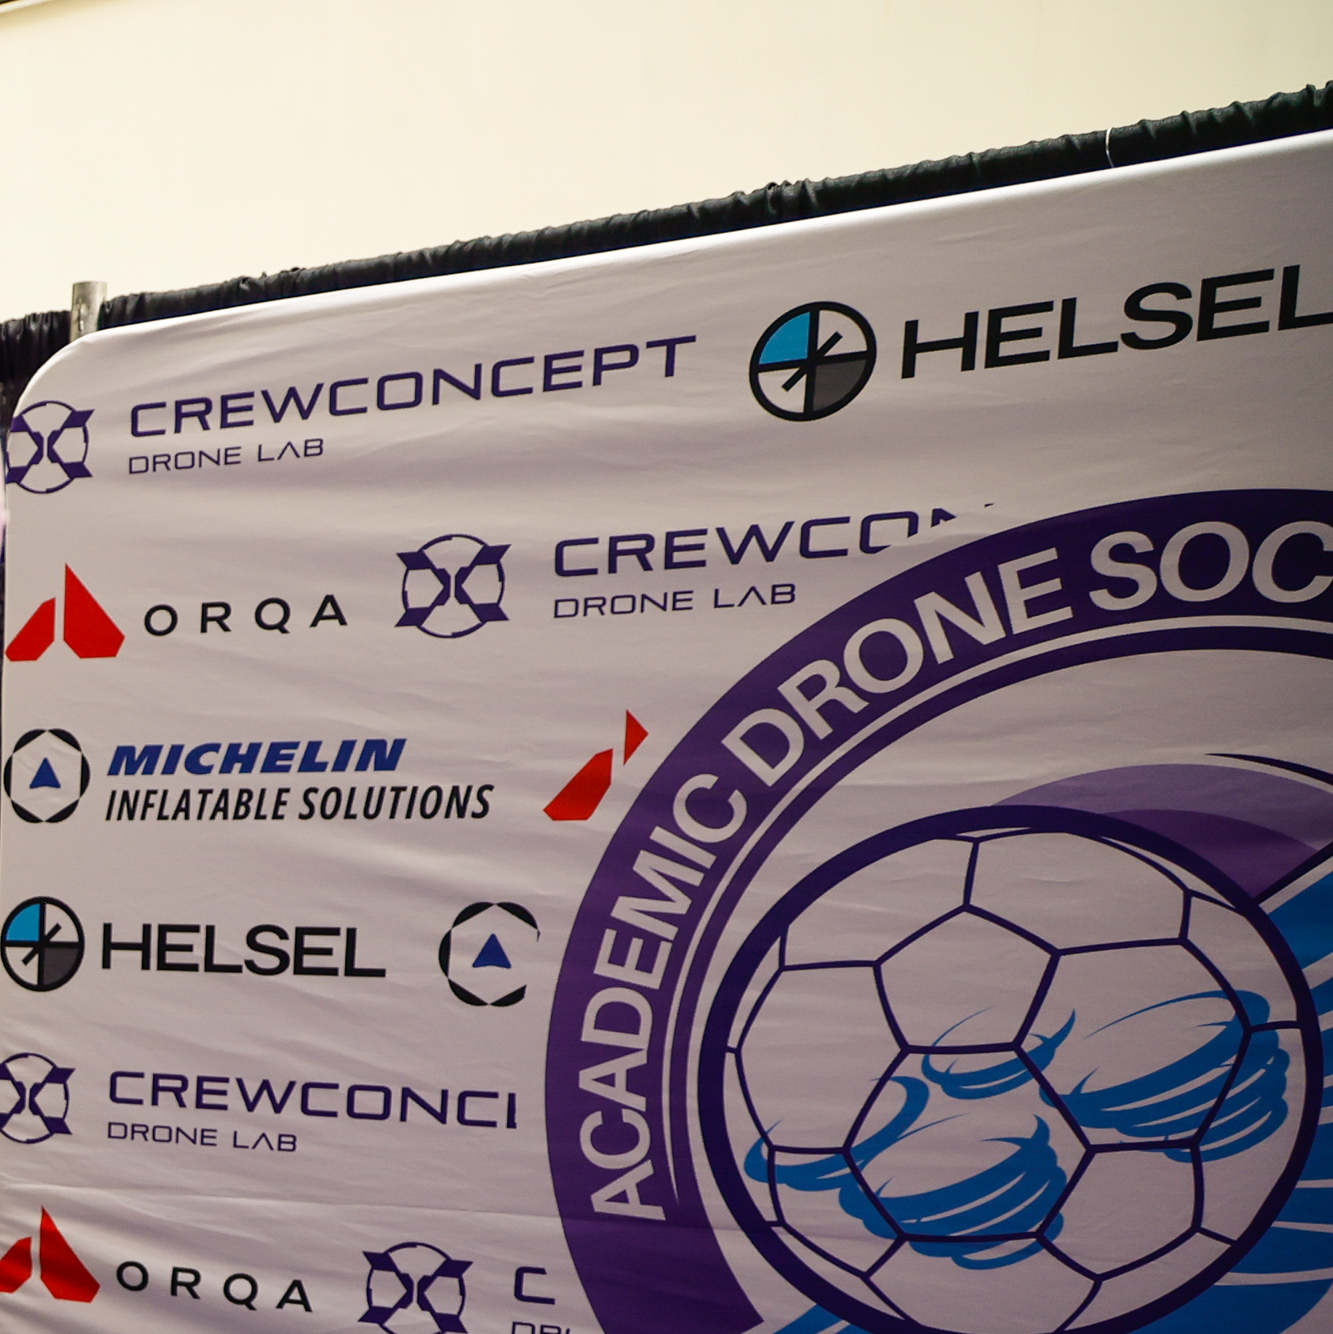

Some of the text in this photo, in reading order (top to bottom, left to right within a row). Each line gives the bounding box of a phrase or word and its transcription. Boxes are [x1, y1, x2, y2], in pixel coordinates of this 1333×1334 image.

[901, 263, 1333, 380] HELSEL
[130, 335, 697, 438] CREWCONCEPT
[128, 438, 325, 475] DRONE LAB
[143, 594, 348, 636] ORQA
[553, 583, 796, 618] DRONE LAB
[107, 738, 407, 777] MICHELIN
[105, 784, 494, 821] INFLATABLE SOLUTIONS
[578, 521, 1333, 1222] ACADEMIC DRONE SOC
[102, 923, 386, 978] HELSEL
[107, 1122, 298, 1153] DRONE LAB
[116, 1260, 314, 1314] ORQA
